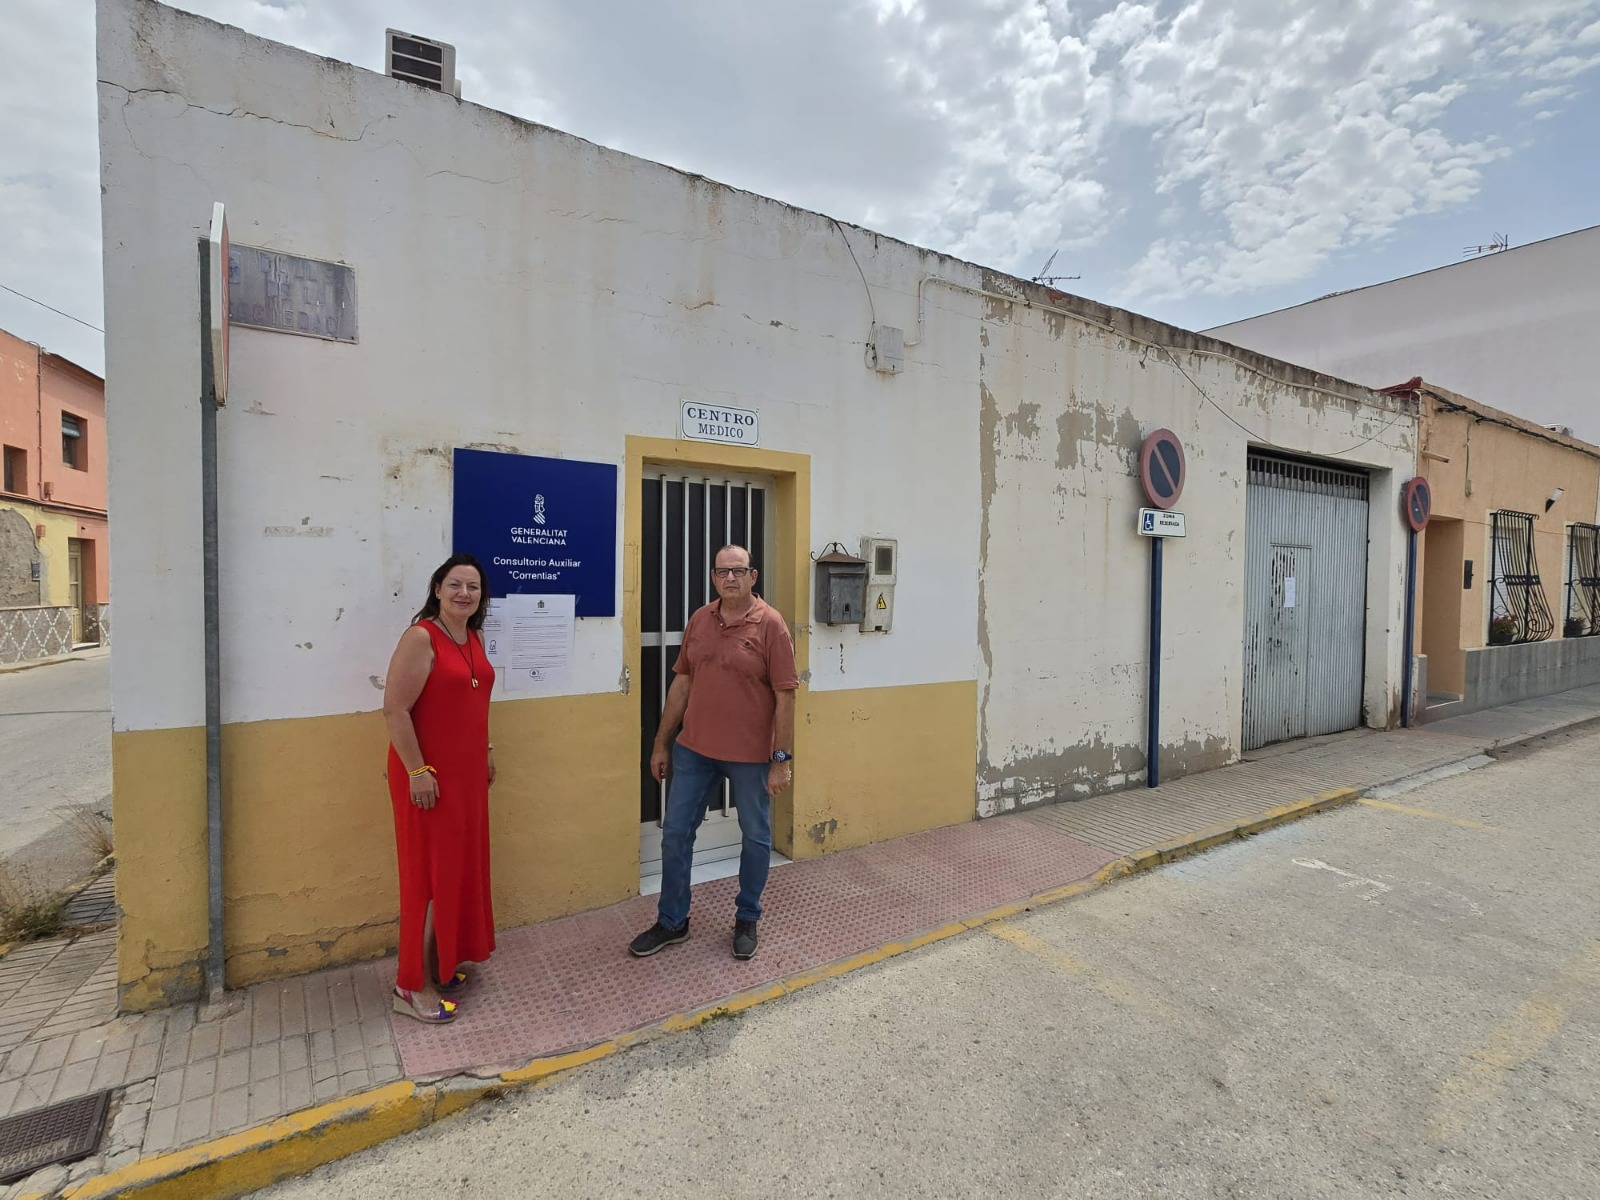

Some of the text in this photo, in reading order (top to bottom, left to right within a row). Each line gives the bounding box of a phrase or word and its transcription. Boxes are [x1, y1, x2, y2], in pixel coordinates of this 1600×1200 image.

[687, 407, 754, 426] CENTRO
[698, 423, 743, 438] MEDICO
[510, 527, 568, 537] GENERALITAT
[511, 536, 567, 546] VALENCIANA
[493, 556, 581, 568] Consultorio Auxiliar
[508, 570, 561, 580] "Correntias"
